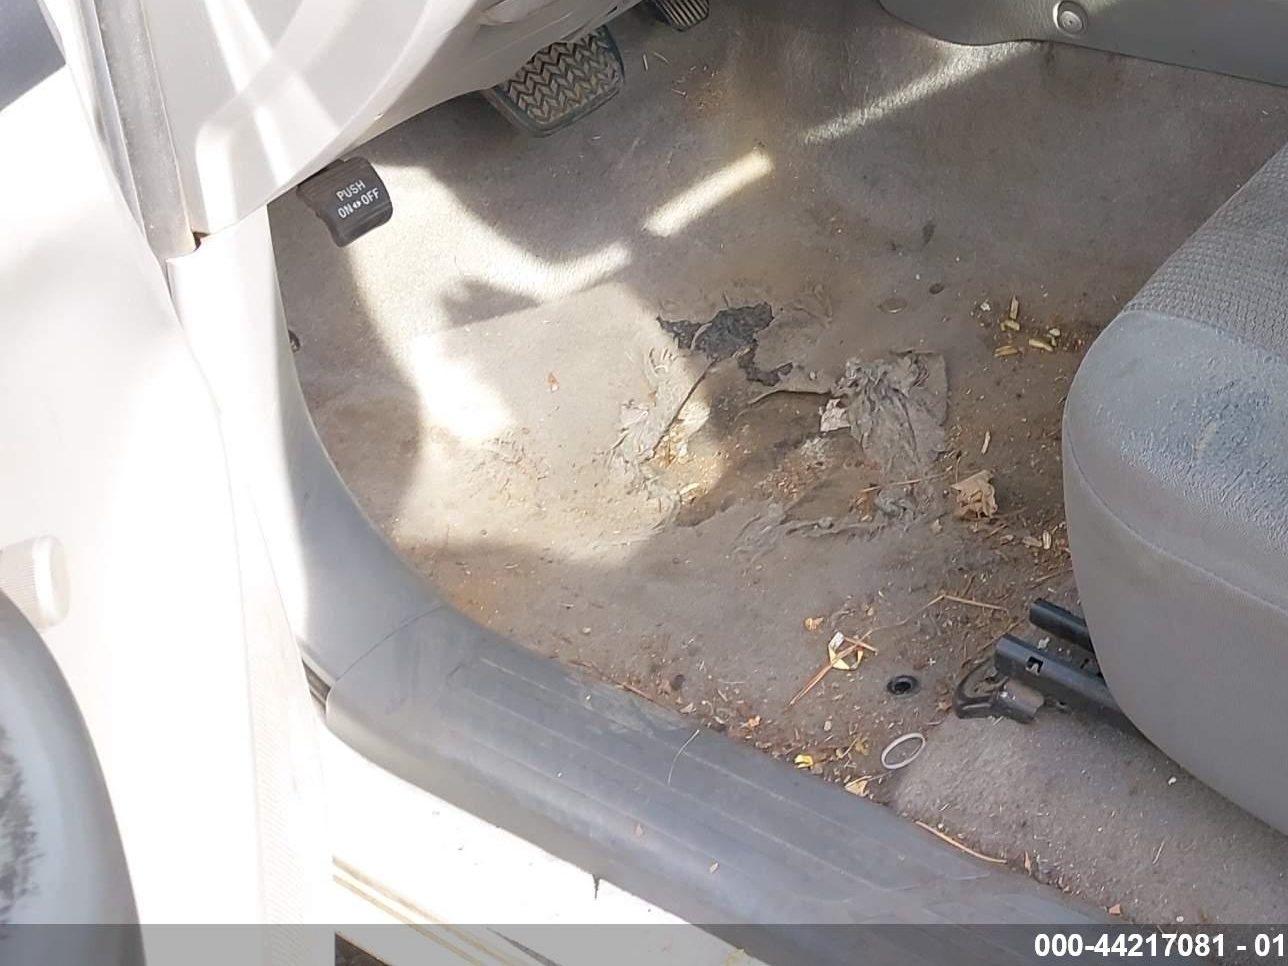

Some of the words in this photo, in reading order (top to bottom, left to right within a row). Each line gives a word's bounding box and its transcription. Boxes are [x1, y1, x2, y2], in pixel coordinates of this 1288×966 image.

[336, 180, 366, 202] PUSH
[337, 204, 354, 219] ON
[360, 188, 380, 206] OFF
